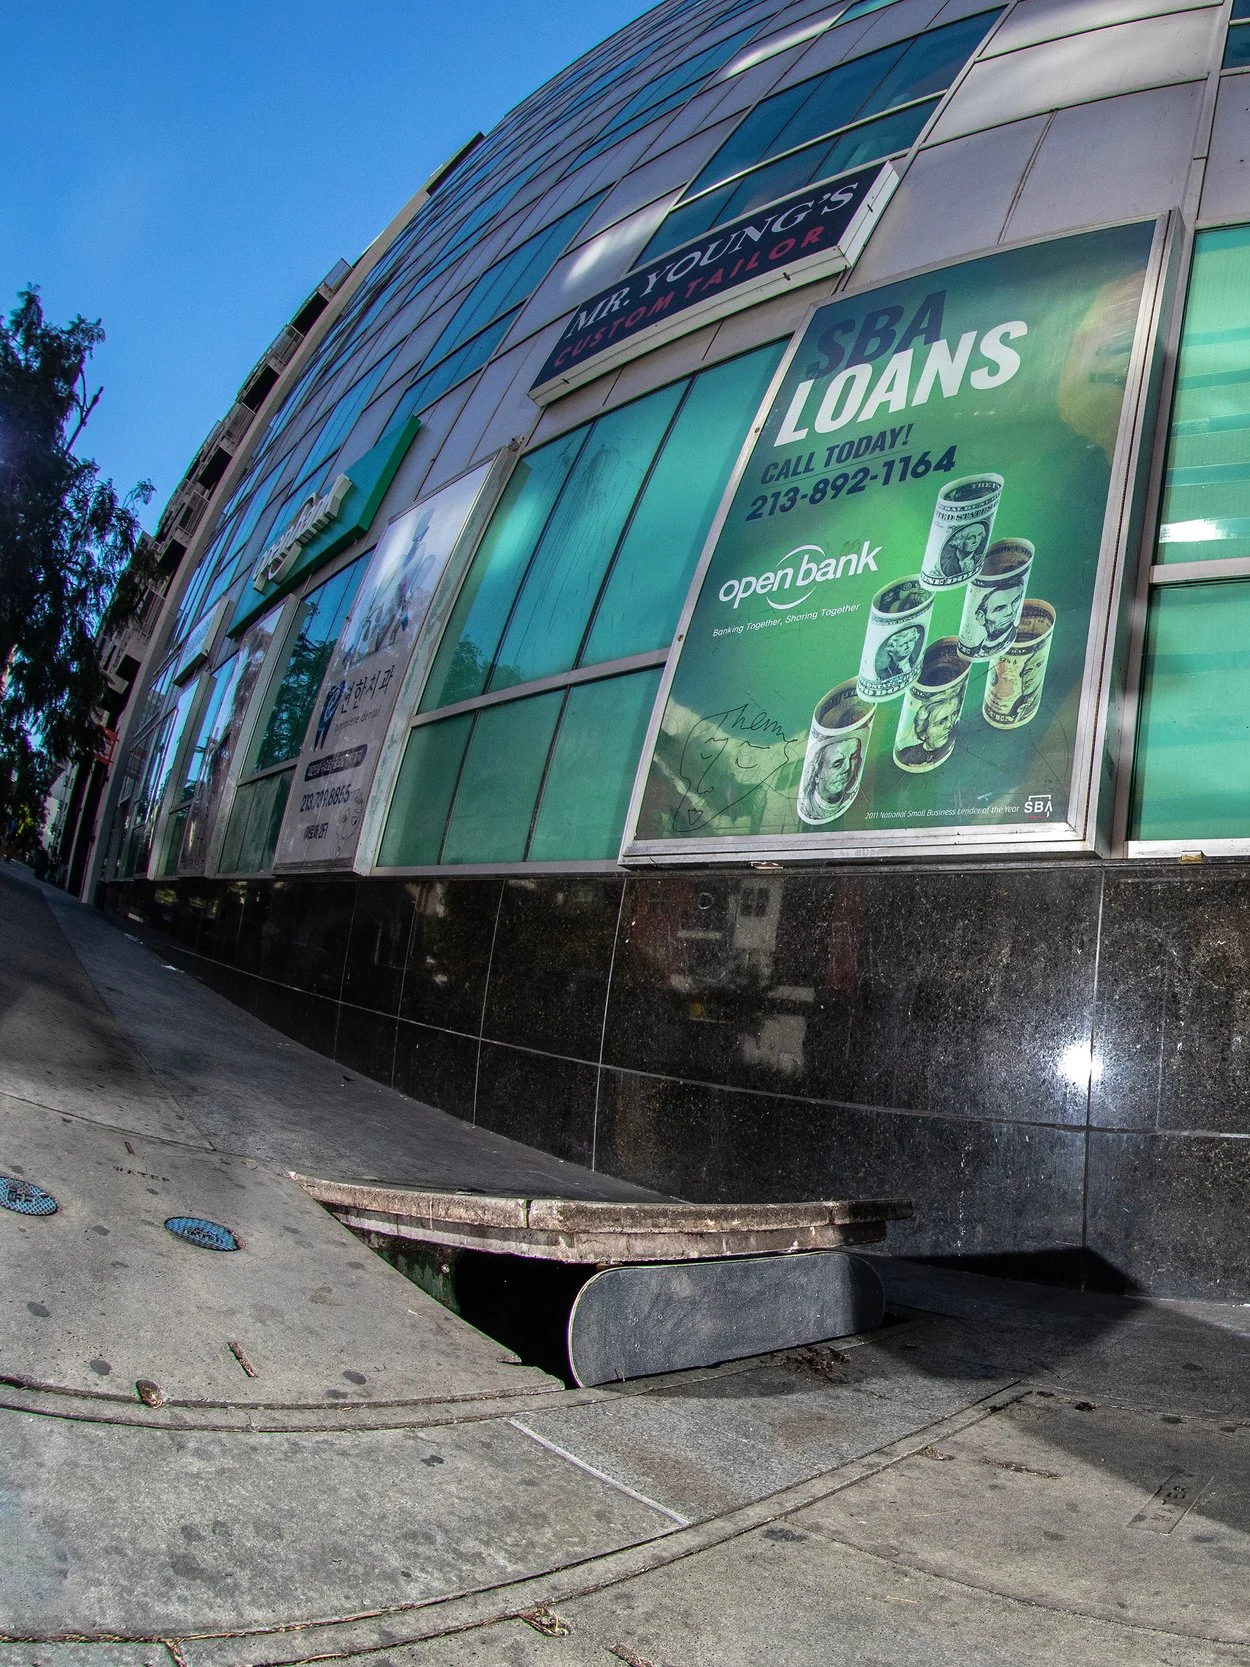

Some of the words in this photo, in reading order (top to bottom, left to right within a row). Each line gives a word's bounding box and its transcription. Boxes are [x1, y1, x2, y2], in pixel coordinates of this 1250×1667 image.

[554, 292, 672, 367] CUSTOM
[685, 226, 824, 299] TAILOR
[564, 290, 631, 339] MR.
[640, 182, 858, 297] YOUNG'S
[805, 290, 947, 380] SBA
[773, 320, 1028, 447] LOANS
[745, 445, 958, 522] 213-892-1164
[760, 451, 816, 485] CALL
[824, 423, 914, 468] TODAY!
[712, 623, 744, 638] Banking
[746, 618, 783, 632] Together,
[785, 611, 818, 625] Sharing
[821, 603, 861, 617] Together
[865, 811, 879, 820] 2011
[880, 810, 906, 820] National
[907, 809, 926, 818] Small
[926, 808, 956, 818] Business
[957, 807, 981, 816] Lender
[981, 805, 992, 815] of
[992, 805, 1002, 814] the
[1003, 804, 1020, 814] Year
[1023, 799, 1053, 818] SBA
